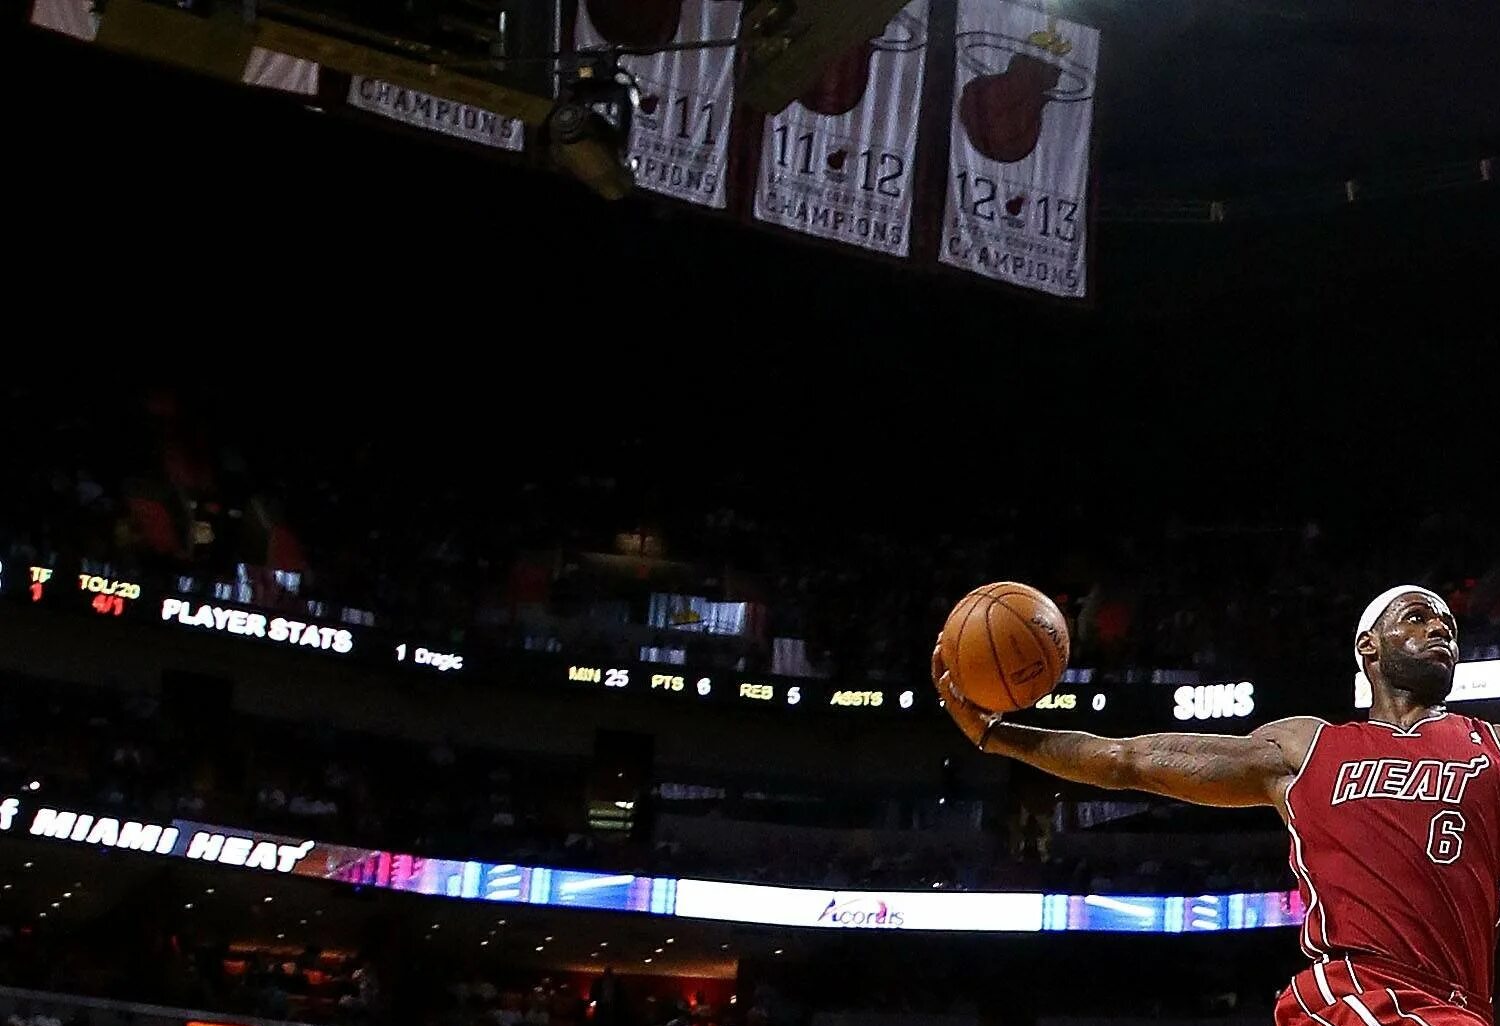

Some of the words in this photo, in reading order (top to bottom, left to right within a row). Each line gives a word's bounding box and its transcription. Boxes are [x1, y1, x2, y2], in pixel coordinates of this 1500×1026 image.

[360, 79, 513, 139] CHAMPIONS
[776, 125, 815, 175] 11
[860, 150, 904, 198] 12
[767, 193, 901, 245] CHAMPIONS
[957, 171, 996, 222] 12
[1037, 196, 1077, 243] 13
[949, 237, 1078, 288] CHAMPIONS
[162, 599, 266, 638] PLAYER
[268, 618, 353, 653] STATS
[605, 668, 629, 688] 25
[651, 674, 685, 691] PTS
[740, 683, 774, 699] REB
[788, 686, 801, 704] 5
[1173, 681, 1255, 721] SUNS
[1331, 754, 1489, 806] HEAT
[29, 808, 180, 856] MIAMI
[186, 832, 316, 873] HEAT
[1426, 809, 1466, 864] 6
